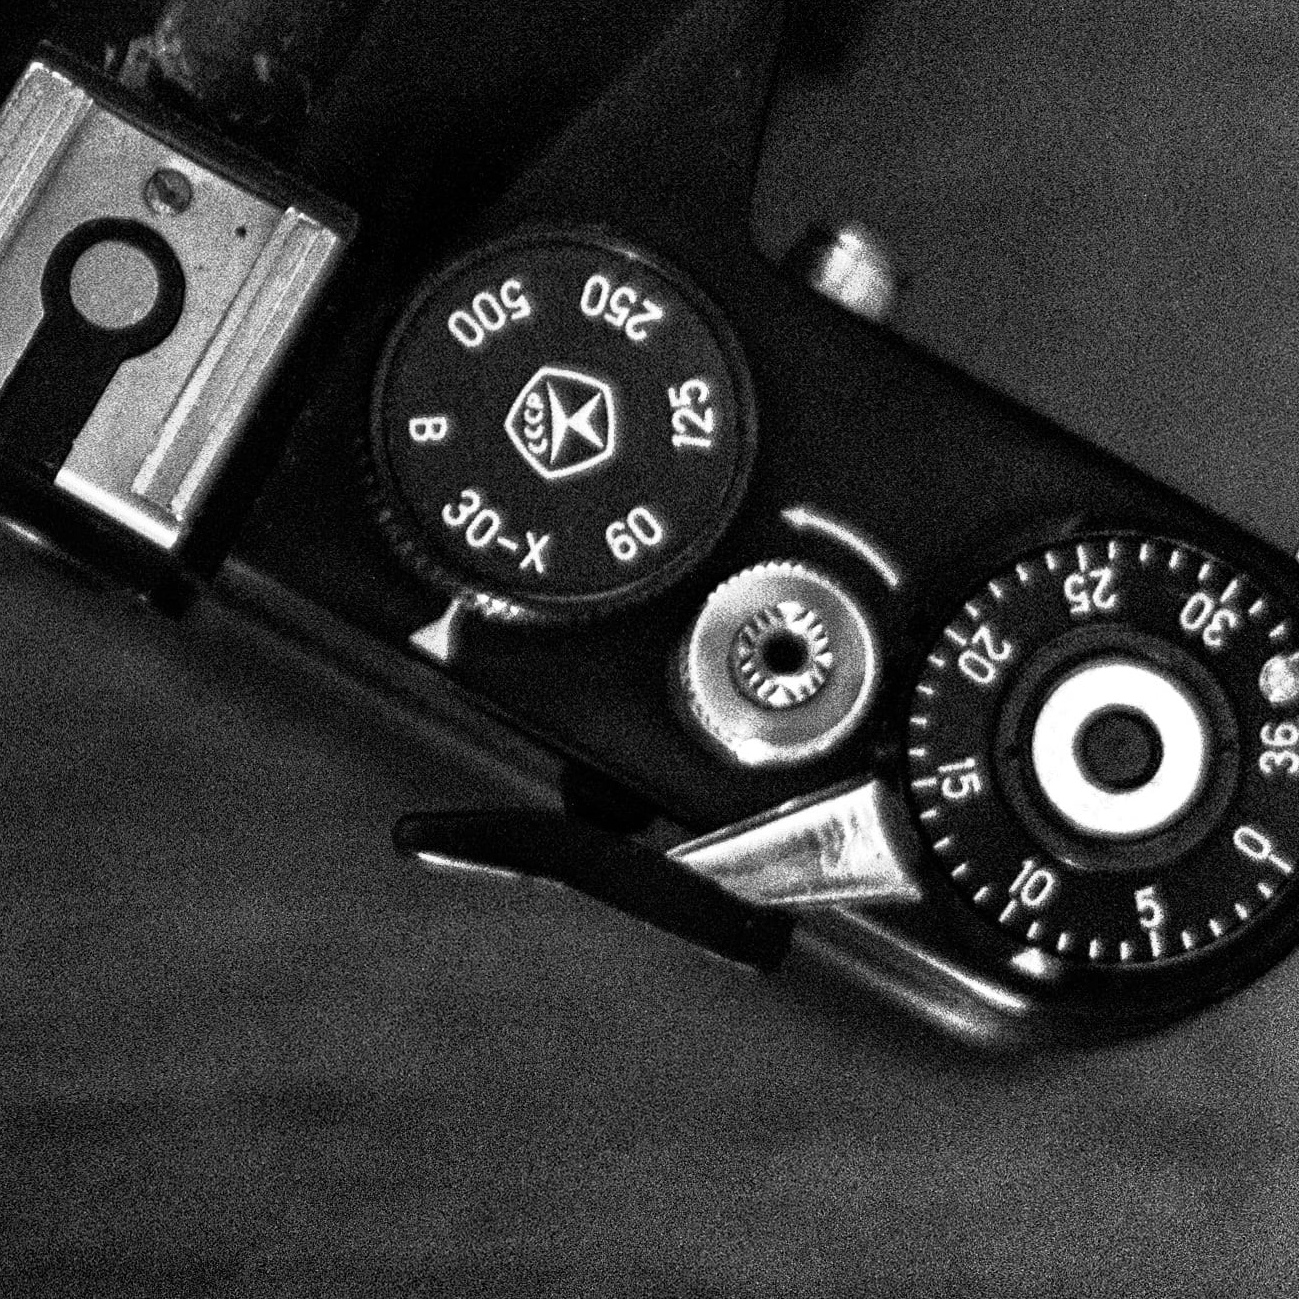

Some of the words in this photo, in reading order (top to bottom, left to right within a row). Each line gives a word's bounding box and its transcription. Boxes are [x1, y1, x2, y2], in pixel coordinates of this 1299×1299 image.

[447, 279, 531, 348] 500
[580, 274, 664, 342] 250
[409, 416, 447, 442] B
[668, 378, 714, 449] 125
[441, 488, 551, 574] 30-X
[605, 506, 663, 562] 60
[1064, 567, 1118, 615] 25
[1180, 591, 1239, 647] 30
[957, 625, 1012, 684] 20
[1258, 721, 1299, 776] 36
[939, 757, 982, 800] 15
[1232, 825, 1271, 861] 0
[1009, 858, 1054, 907] 10
[1135, 886, 1164, 929] 5
